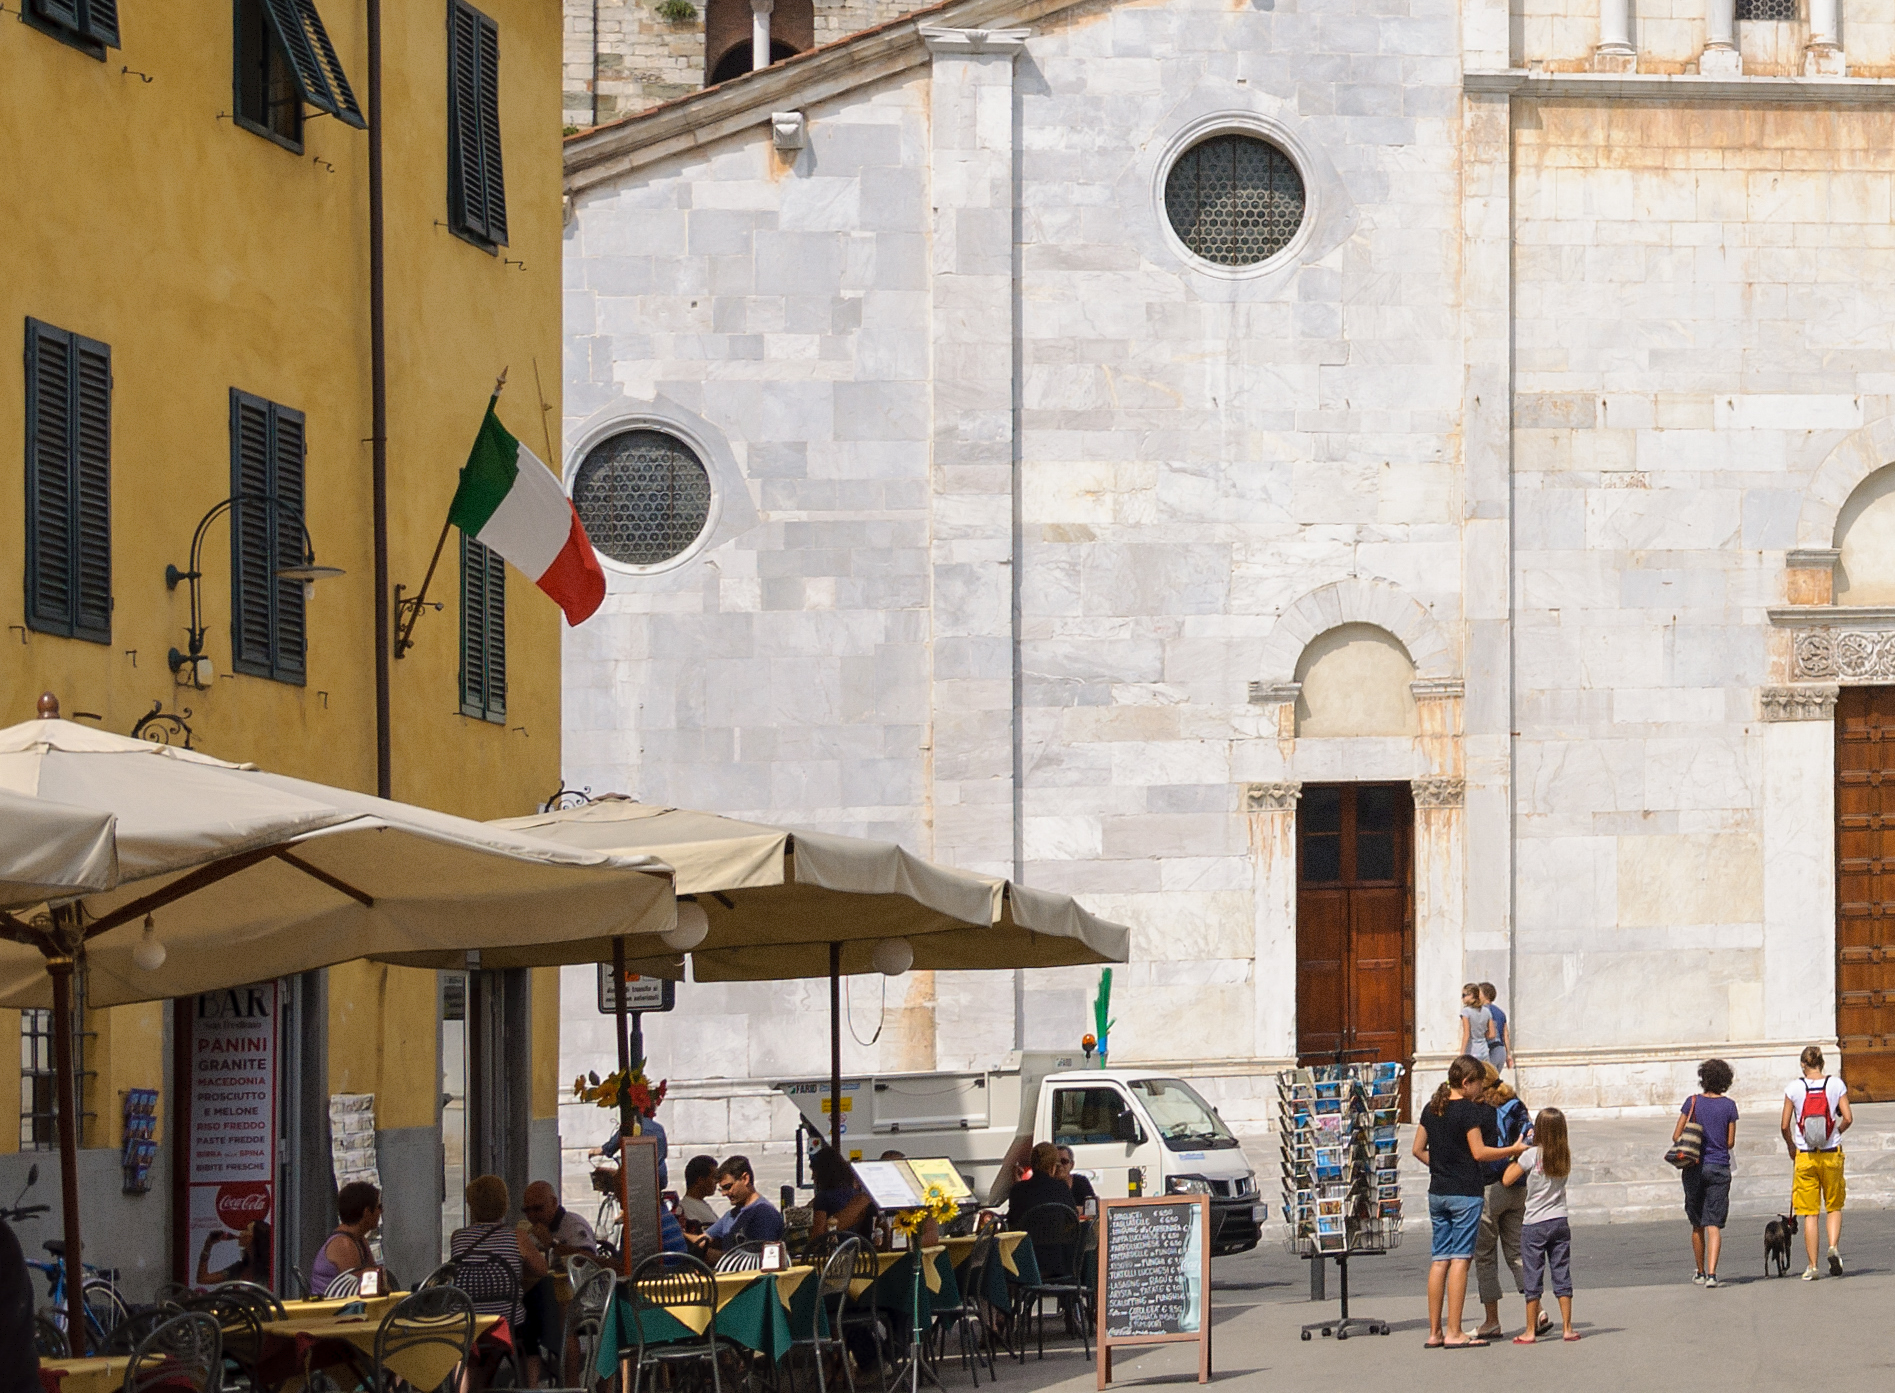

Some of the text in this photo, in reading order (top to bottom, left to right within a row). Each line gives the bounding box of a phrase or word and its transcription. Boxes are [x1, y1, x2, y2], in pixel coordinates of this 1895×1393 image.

[197, 988, 270, 1018] BAR
[197, 1037, 267, 1053] PANINI
[199, 1058, 267, 1072] GRANITE
[197, 1077, 266, 1086] MACEDONIA
[197, 1091, 266, 1102] PROSCIUTTO
[203, 1107, 259, 1117] E MELONE
[196, 1121, 266, 1132] RISO FREDDO
[196, 1135, 265, 1145] PASTE FREDDE
[196, 1150, 222, 1158] BIRRA
[239, 1149, 265, 1157] SPINA
[196, 1163, 265, 1173] BIBITE FRESCHE
